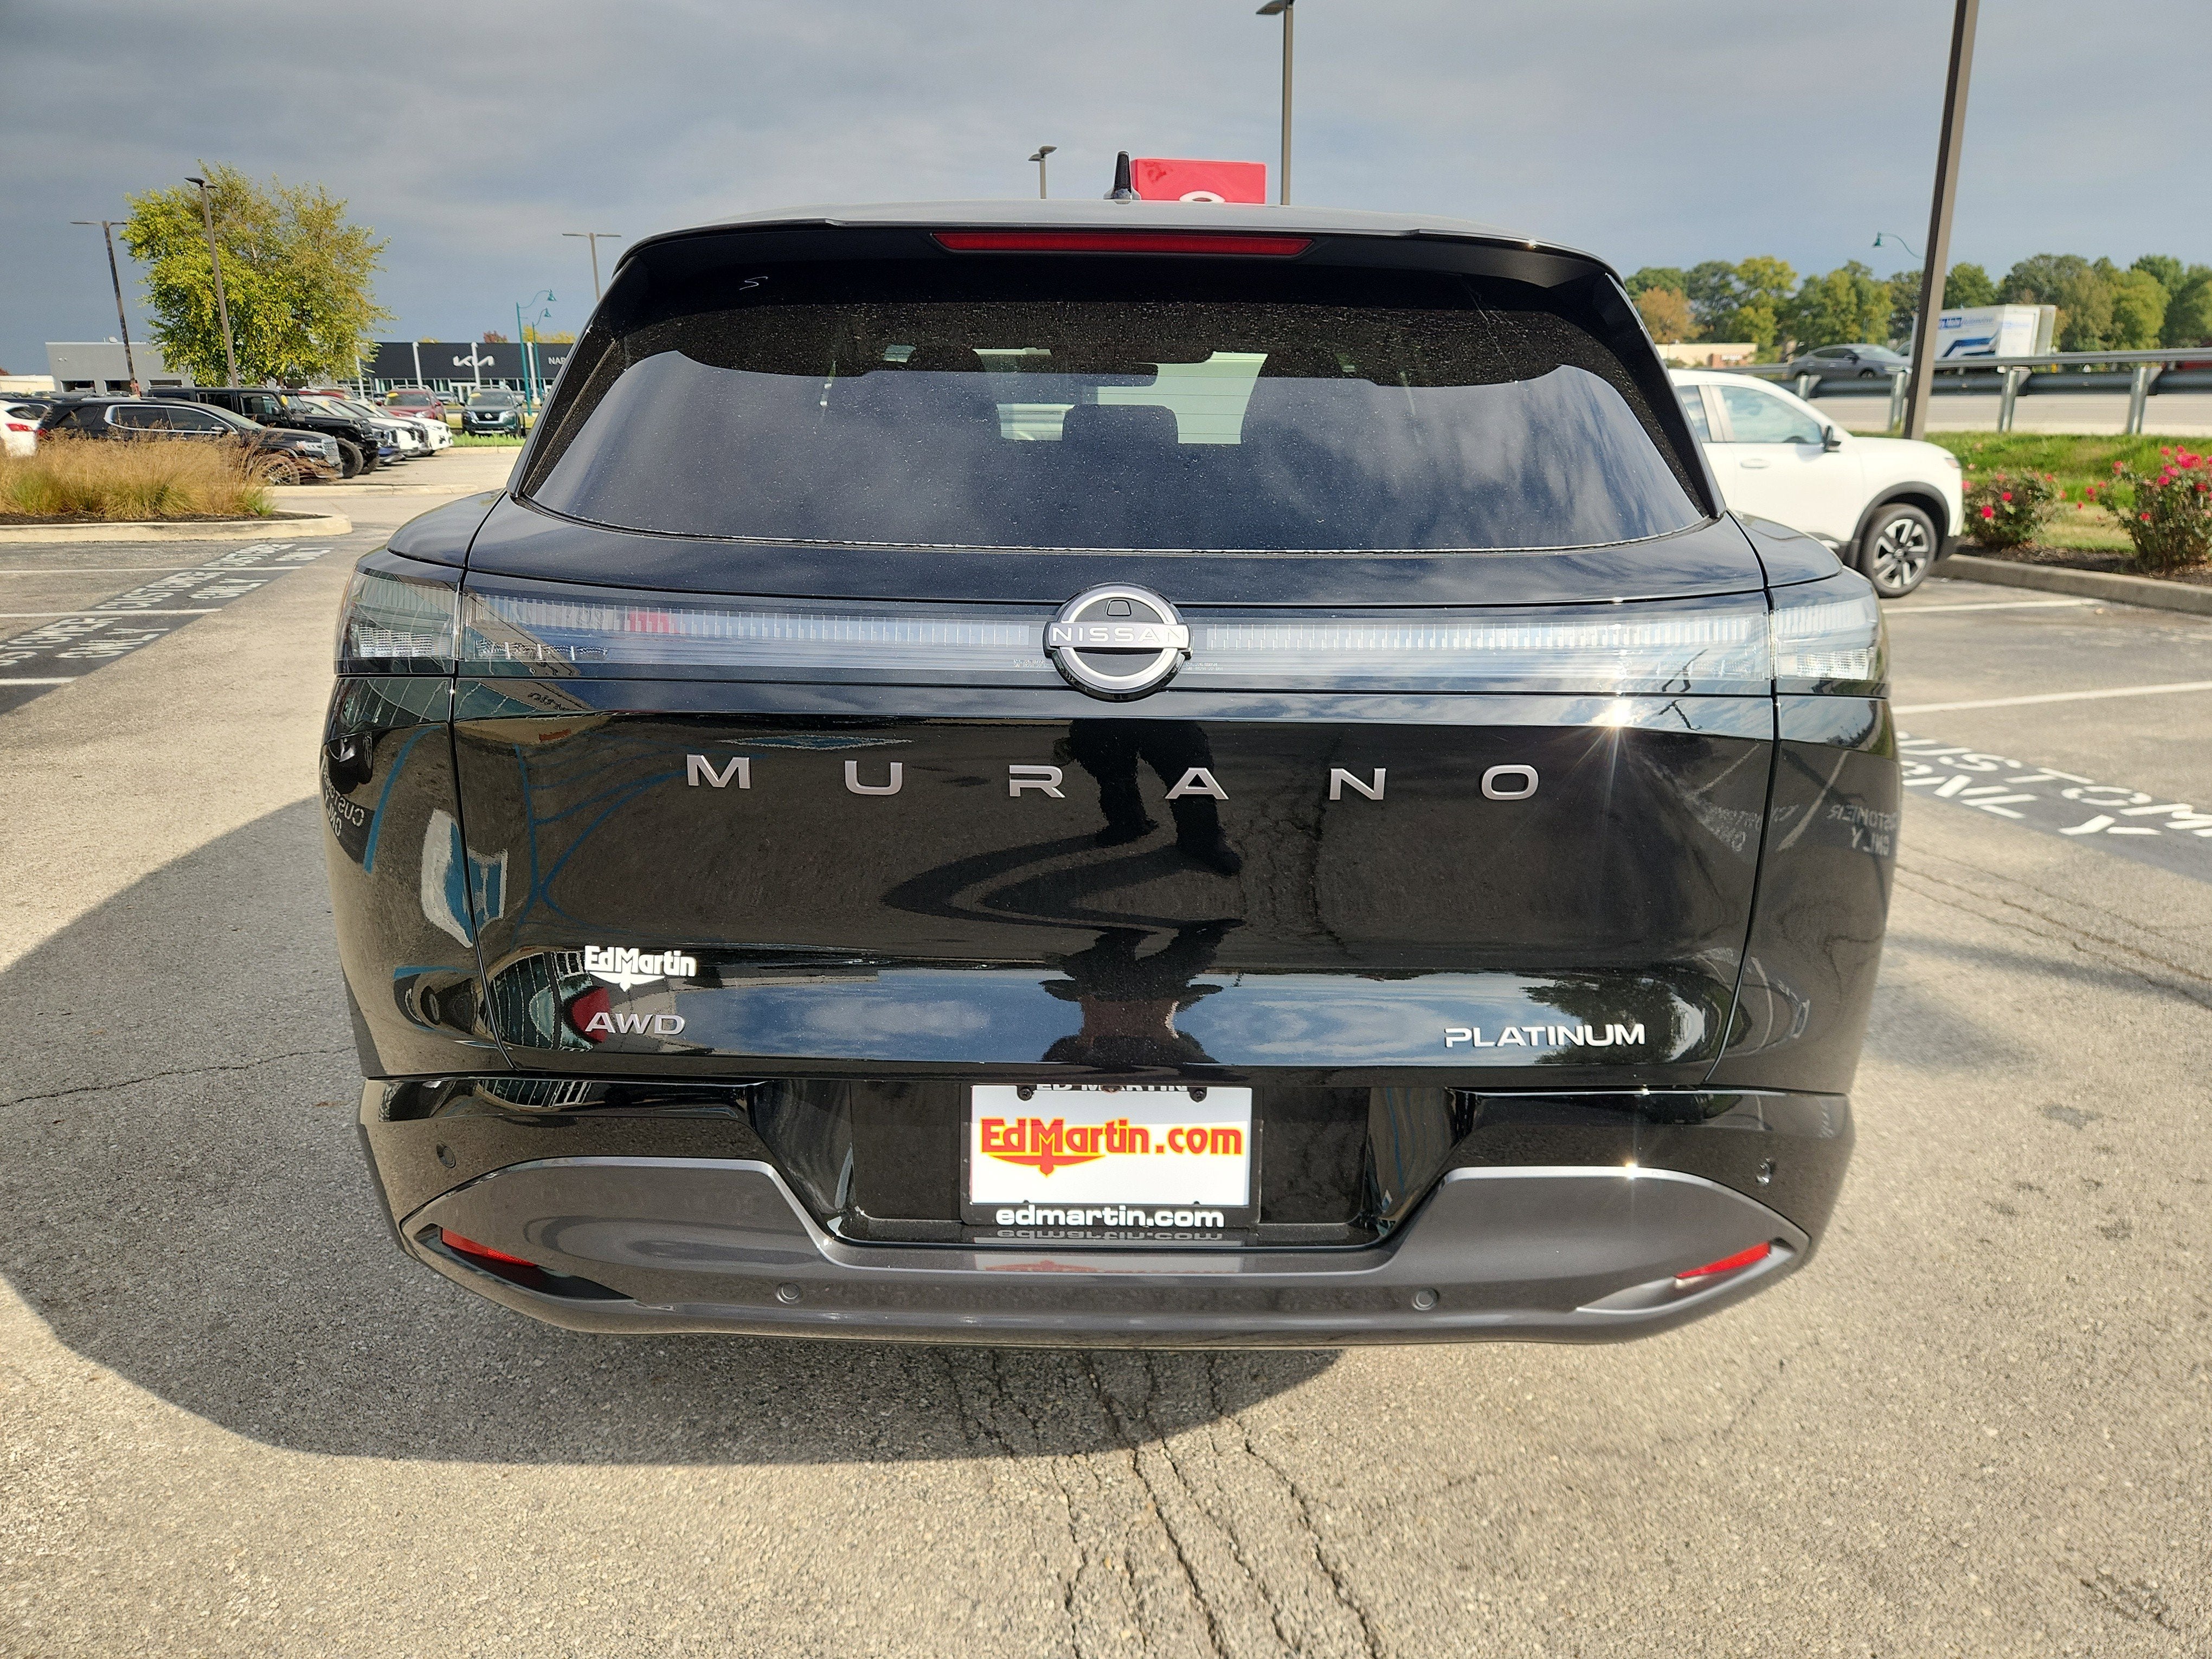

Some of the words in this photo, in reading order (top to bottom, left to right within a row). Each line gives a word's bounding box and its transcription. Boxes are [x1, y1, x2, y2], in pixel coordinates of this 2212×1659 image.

[190, 578, 268, 599] ONLY
[0, 617, 122, 666] STOMER
[55, 628, 170, 658] ONLY
[1052, 627, 1185, 642] NISSAN
[687, 754, 1539, 800] MURANO
[584, 945, 697, 976] EdMartin
[585, 1012, 685, 1034] AWD
[1444, 1024, 1645, 1047] PLATINUM
[980, 1117, 1243, 1155] EdMartin.com
[995, 1205, 1225, 1227] edmartin.com
